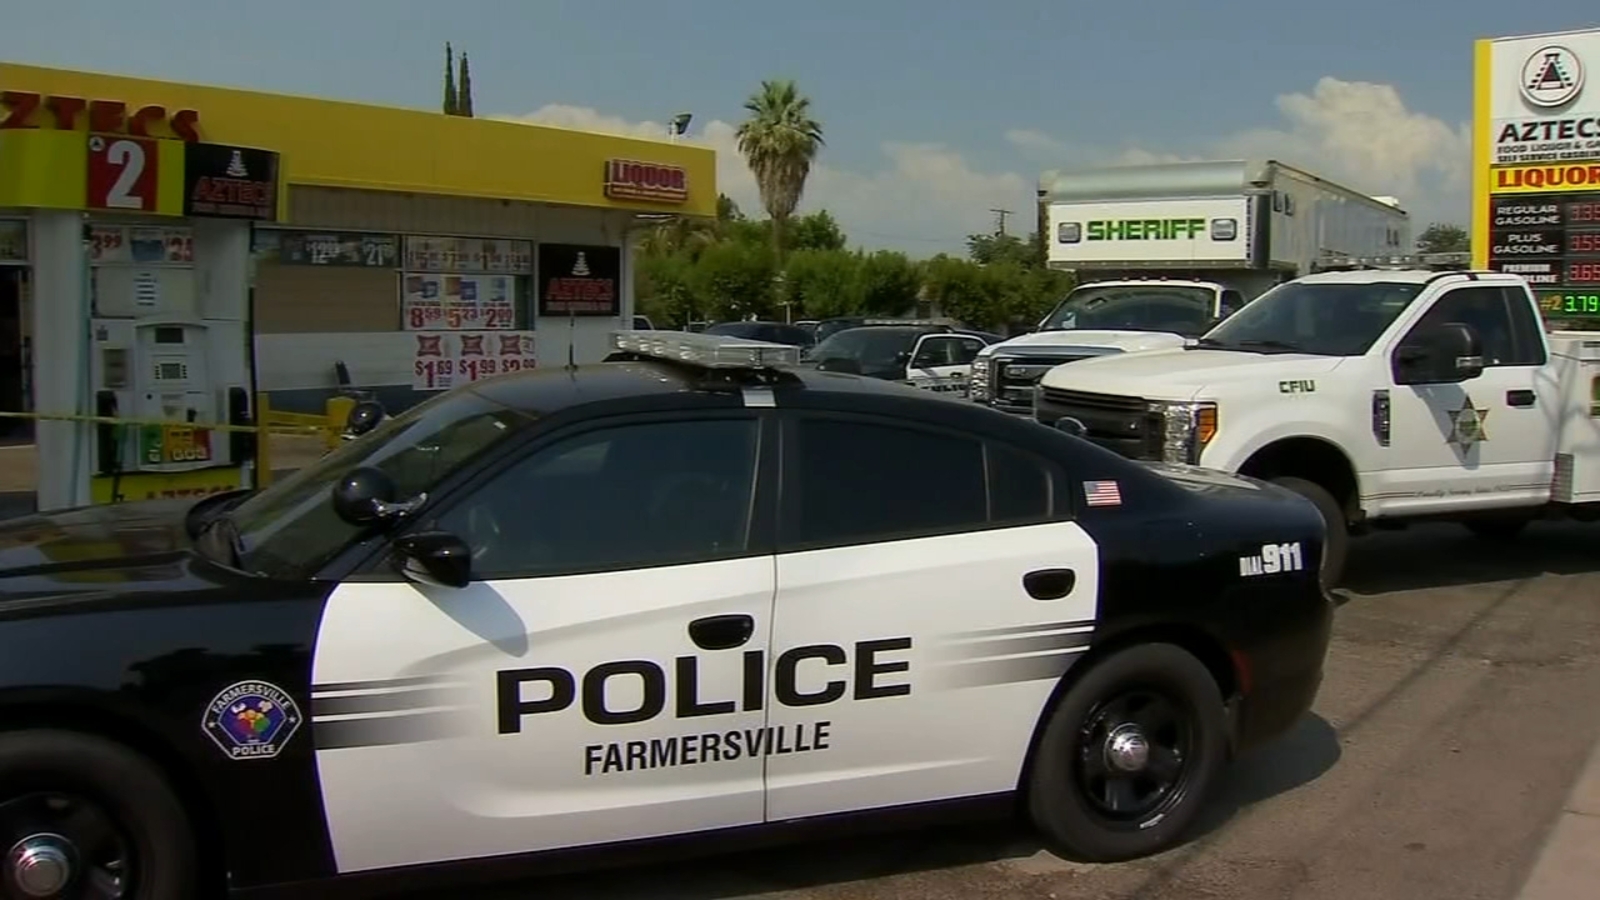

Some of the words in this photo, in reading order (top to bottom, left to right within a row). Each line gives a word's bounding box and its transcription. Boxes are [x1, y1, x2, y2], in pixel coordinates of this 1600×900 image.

[1498, 145, 1527, 153] FOOD
[1531, 142, 1572, 151] LIQUOR
[106, 140, 146, 208] 2
[609, 161, 686, 190] LIQUOR
[1497, 205, 1557, 215] REGULAR
[1495, 216, 1560, 226] GASOLINE
[1087, 219, 1205, 241] SHERIFF
[1508, 234, 1542, 243] PLUS
[1493, 245, 1559, 255] GASOLINE
[1279, 380, 1315, 393] CFIU
[1261, 542, 1303, 574] 911
[496, 636, 913, 735] POLICE
[211, 684, 292, 715] FARMERSVILLE
[232, 744, 276, 756] POLICE
[584, 721, 832, 775] FARMERSVILLE
